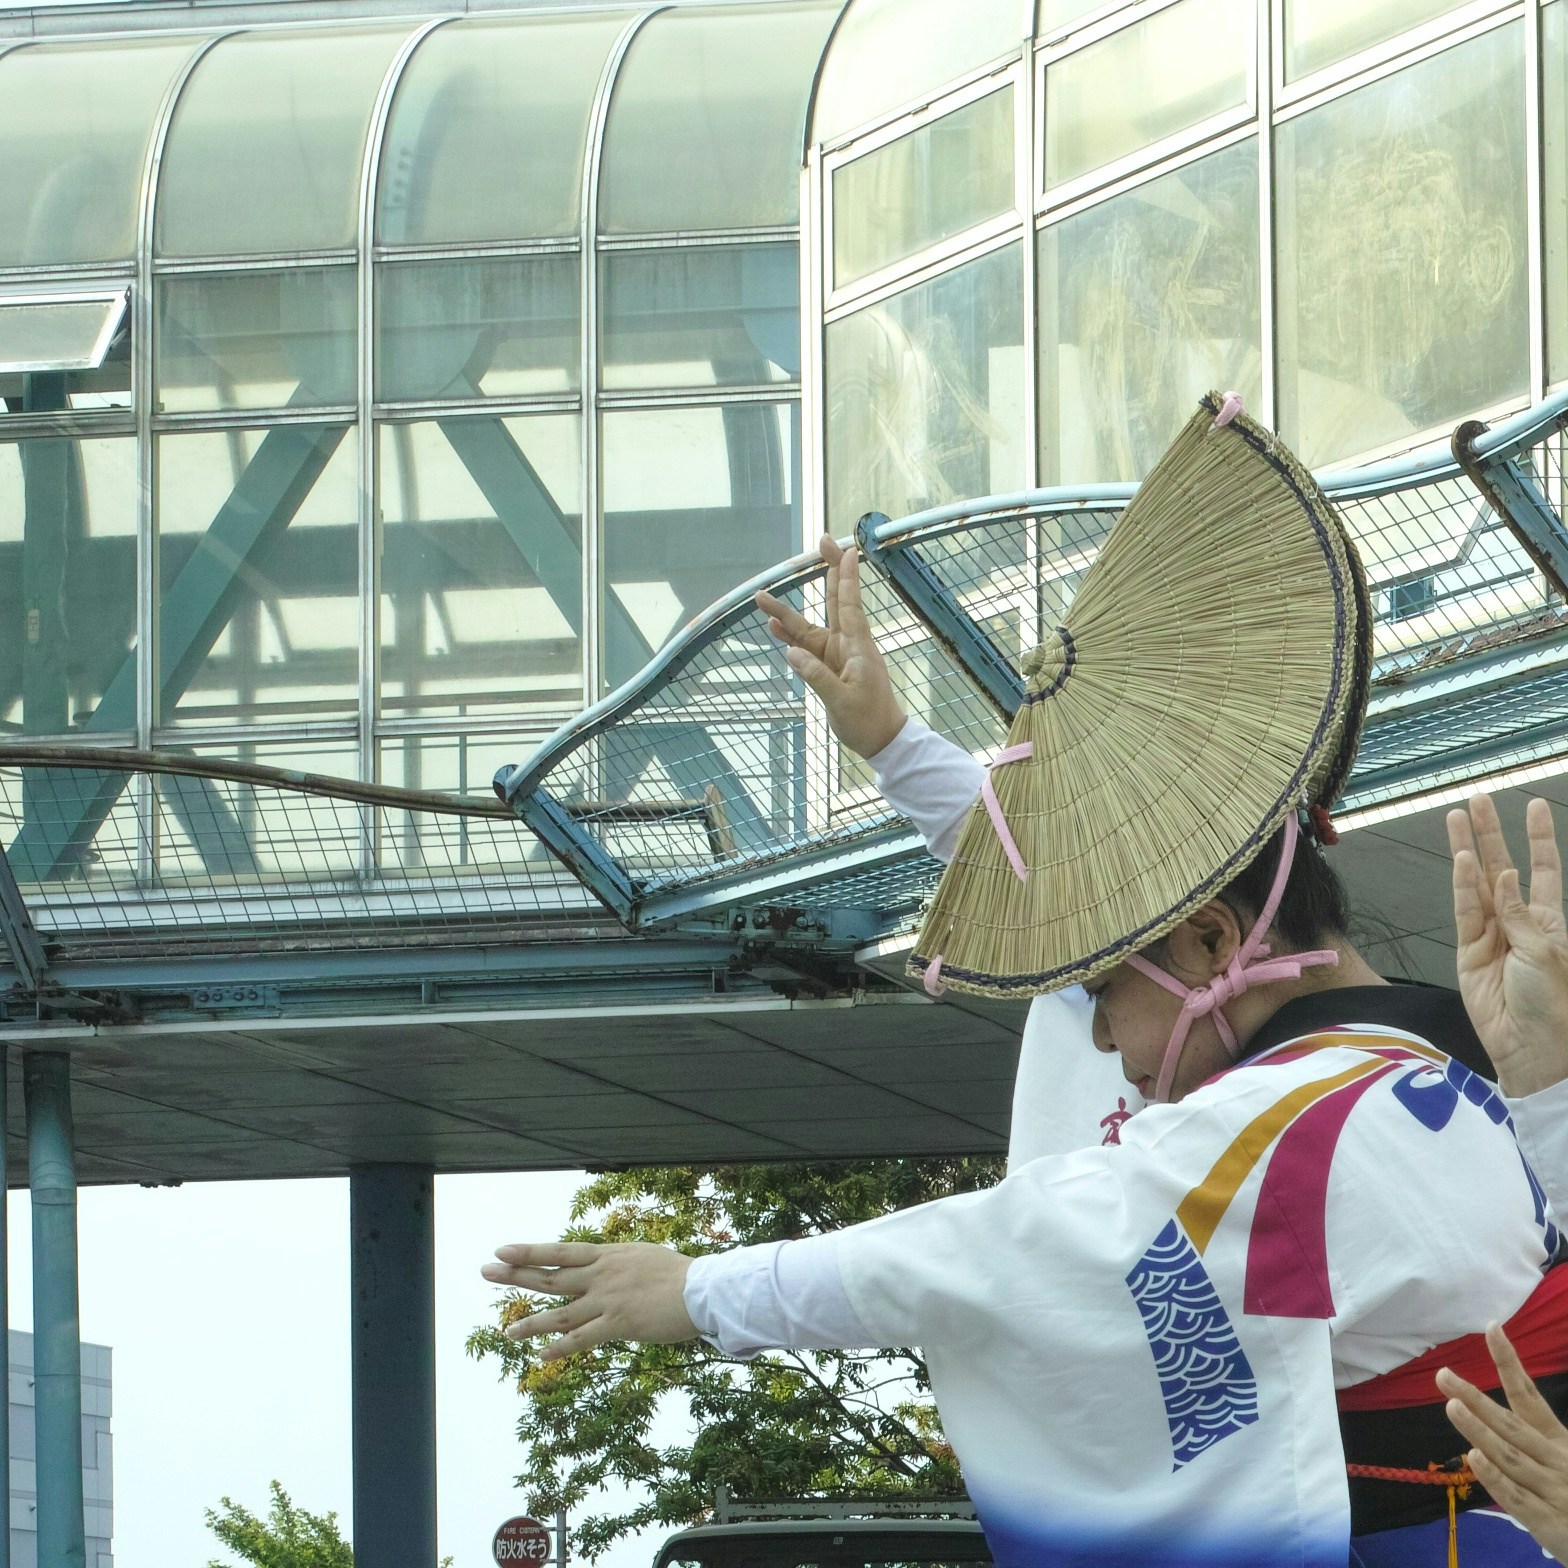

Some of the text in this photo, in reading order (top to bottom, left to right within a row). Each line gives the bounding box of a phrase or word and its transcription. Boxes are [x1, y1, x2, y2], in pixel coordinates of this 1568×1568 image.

[496, 1538, 547, 1559] 防火水そう
